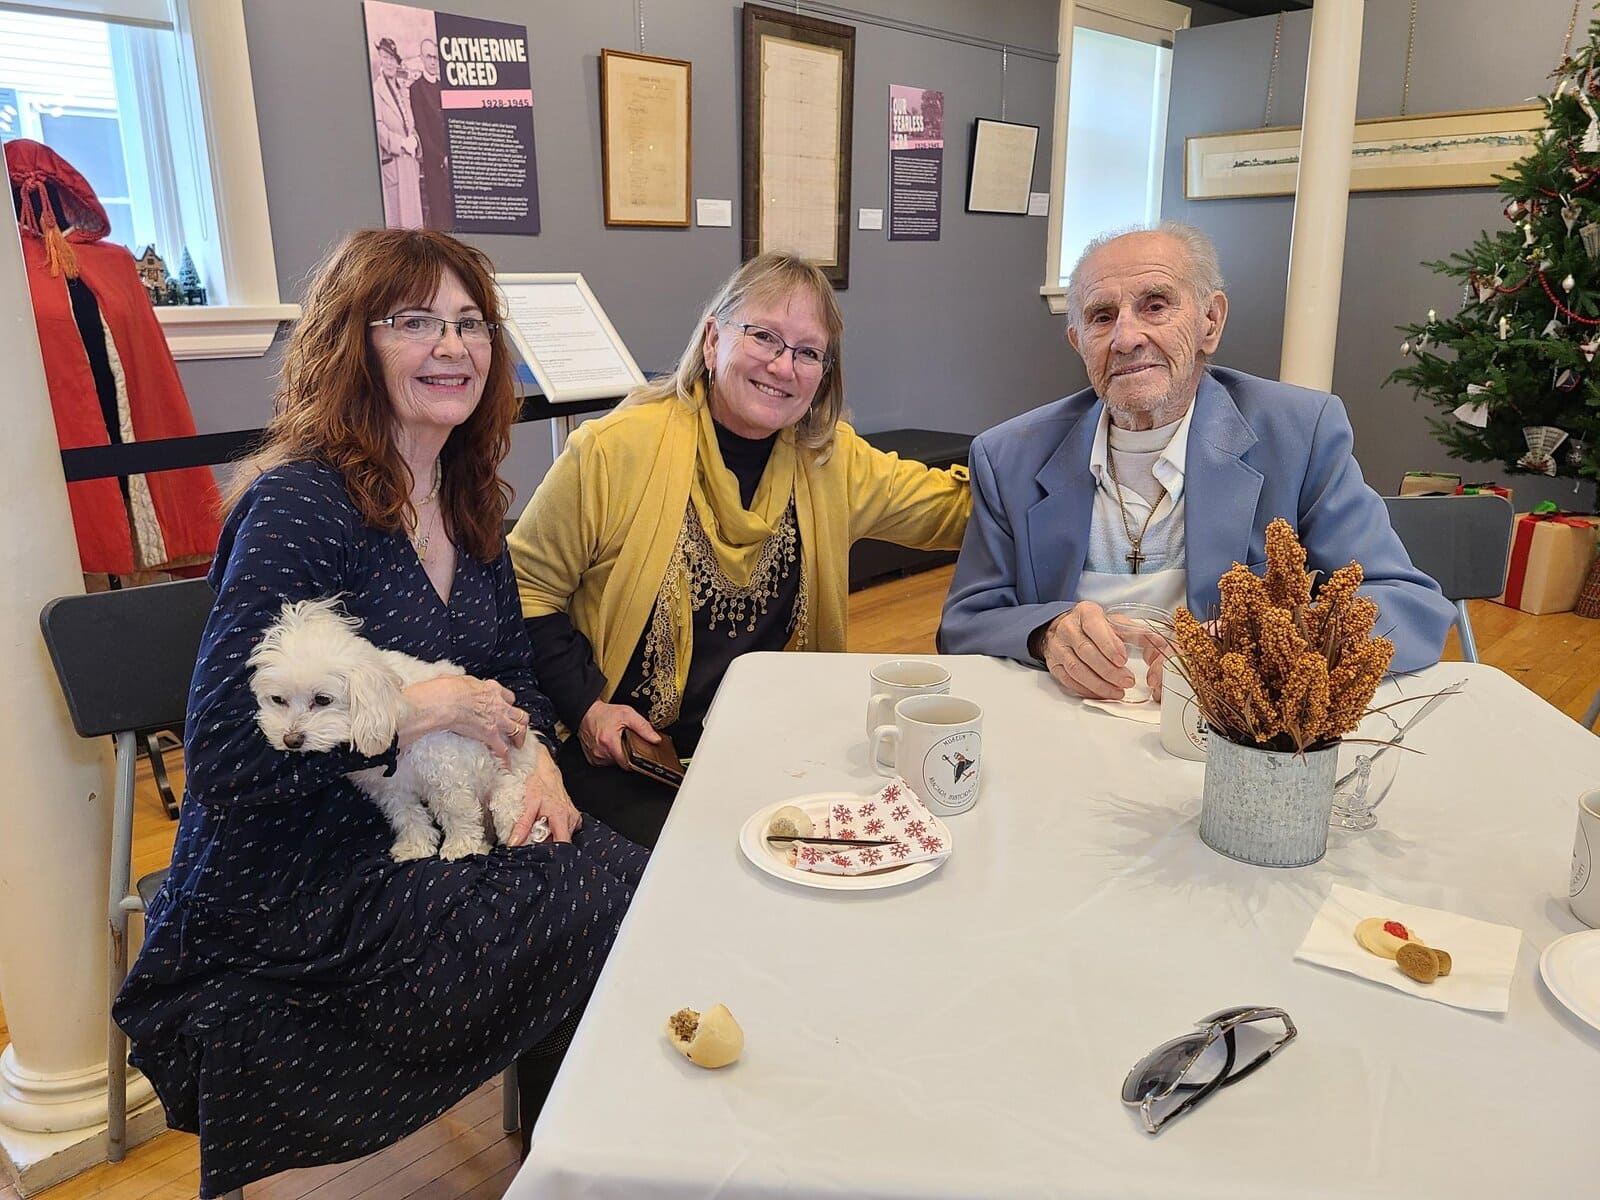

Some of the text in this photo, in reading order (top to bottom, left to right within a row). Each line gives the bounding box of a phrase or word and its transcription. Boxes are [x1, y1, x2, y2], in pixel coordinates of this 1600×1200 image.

[440, 37, 527, 62] CATHERINE
[446, 62, 498, 86] CREED
[481, 99, 529, 109] 1928-1945
[893, 115, 924, 132] FEARLESS
